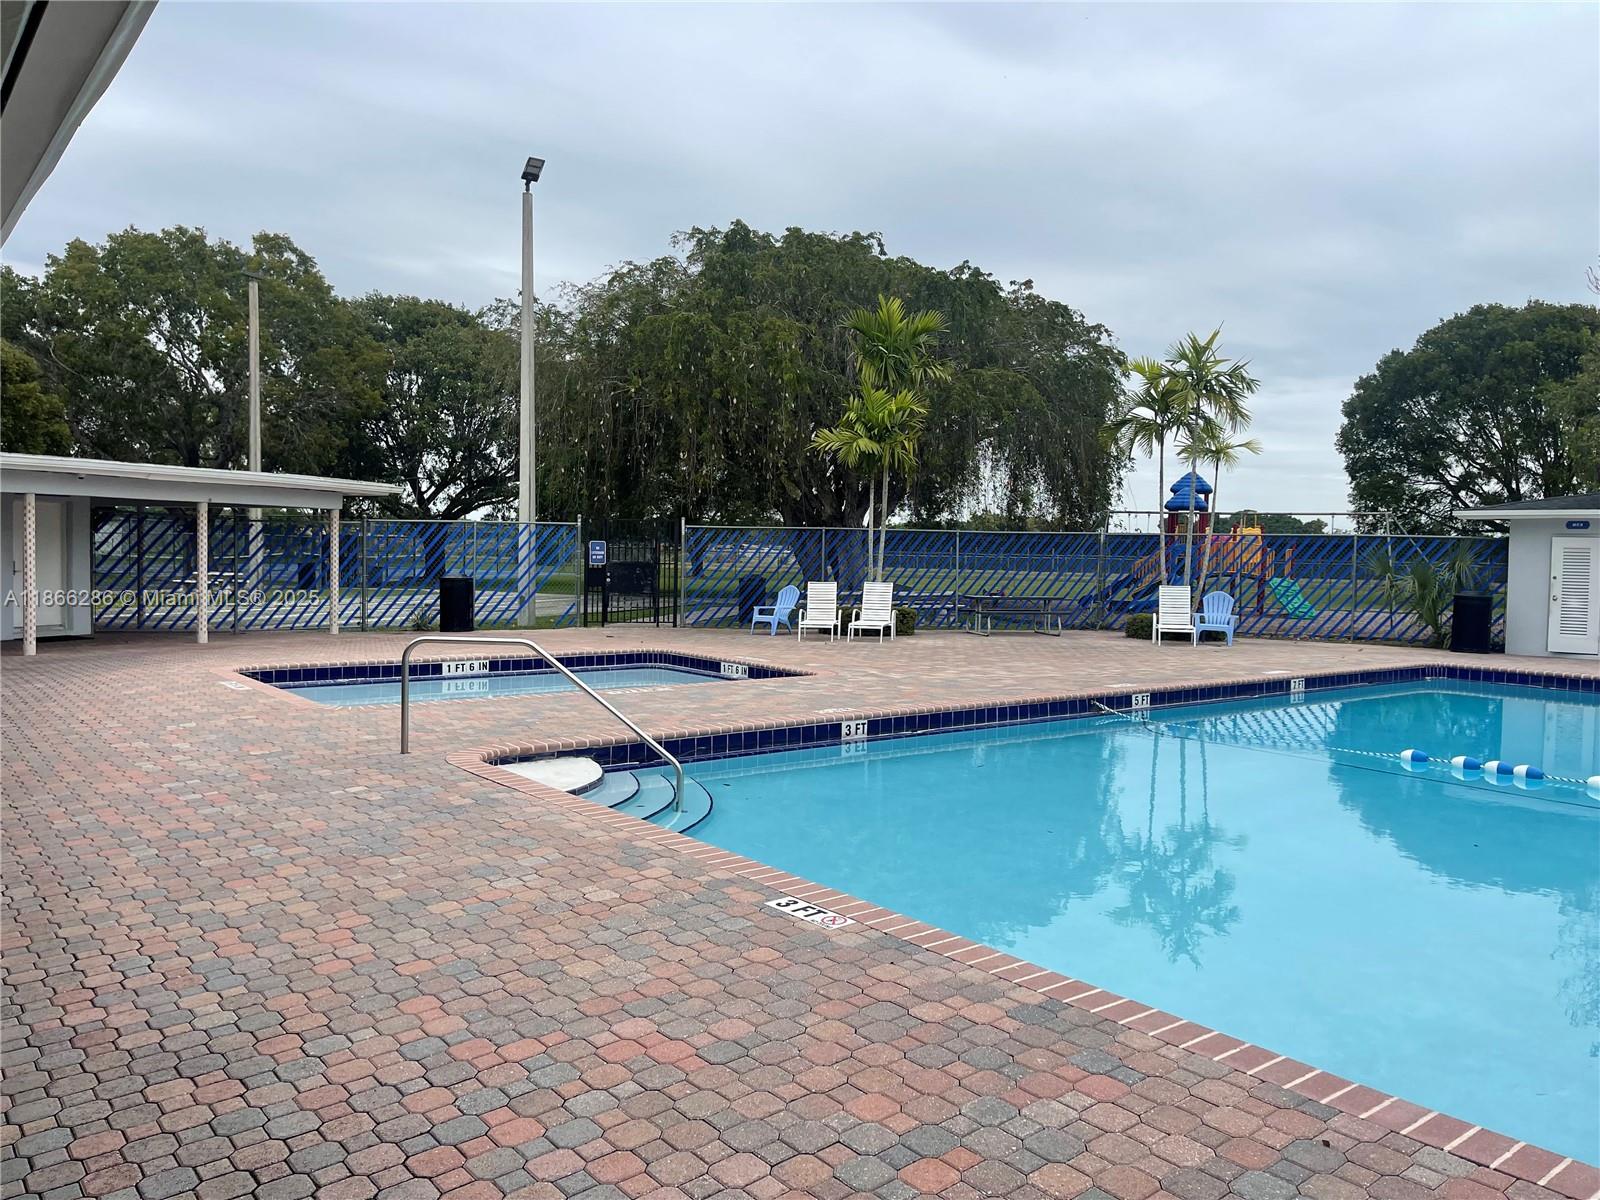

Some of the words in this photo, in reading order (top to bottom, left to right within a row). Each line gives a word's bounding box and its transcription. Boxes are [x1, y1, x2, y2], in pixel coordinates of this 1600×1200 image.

[447, 664, 451, 673] 1
[455, 663, 466, 673] FT
[469, 662, 475, 672] 6
[478, 661, 488, 671] IN
[722, 664, 726, 673] 1
[727, 664, 734, 674] FT
[735, 665, 740, 675] 6
[741, 666, 748, 676] IN
[1134, 695, 1140, 706] 5
[1141, 694, 1150, 706] FT
[845, 724, 852, 737] 3
[855, 722, 867, 736] FT
[790, 906, 828, 917] FT
